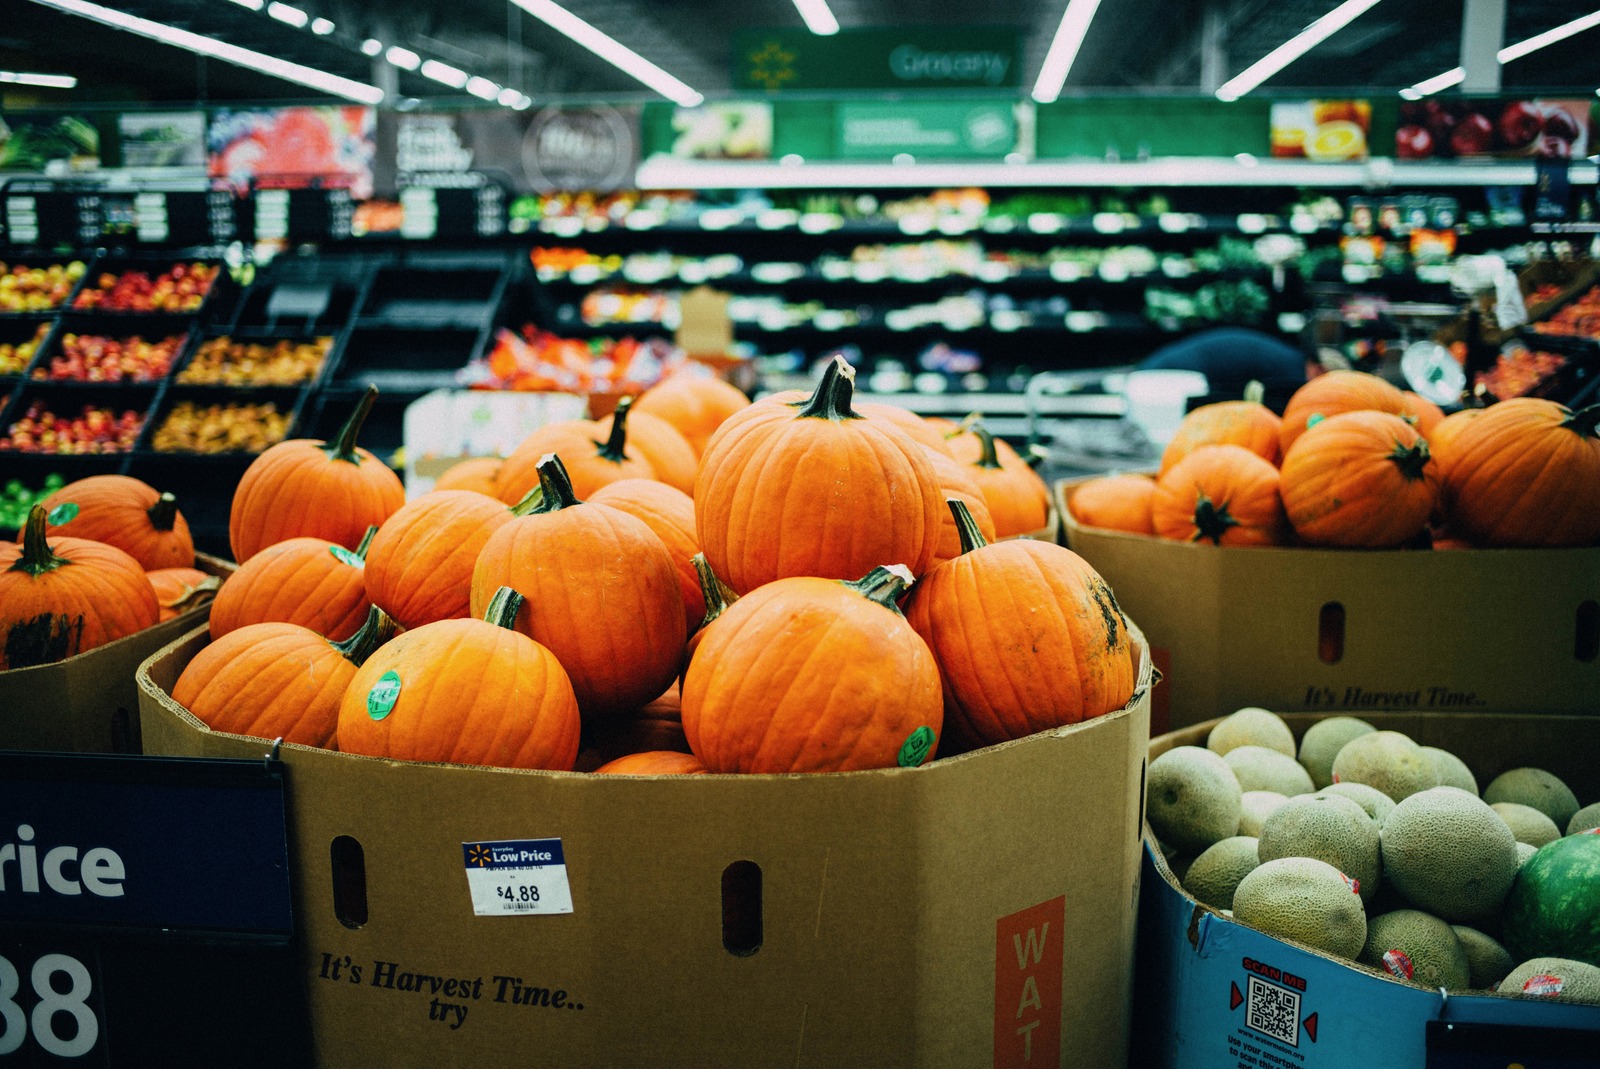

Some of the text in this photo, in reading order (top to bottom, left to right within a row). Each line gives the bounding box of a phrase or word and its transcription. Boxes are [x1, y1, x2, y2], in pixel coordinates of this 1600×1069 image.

[889, 44, 1011, 85] Grocery
[1304, 687, 1336, 706] It's
[1342, 687, 1420, 707] Harvest
[493, 850, 552, 862] Low Price
[497, 885, 540, 902] $4.88
[319, 952, 362, 984] It's
[371, 961, 484, 1000] Harvest
[1243, 958, 1306, 991] SCAN ME
[429, 998, 468, 1030] try
[1228, 1035, 1304, 1069] Use your smartpho
[1229, 1046, 1238, 1056] to
[1240, 1052, 1257, 1065] scan
[1237, 1028, 1305, 1061] www.watermelon.org
